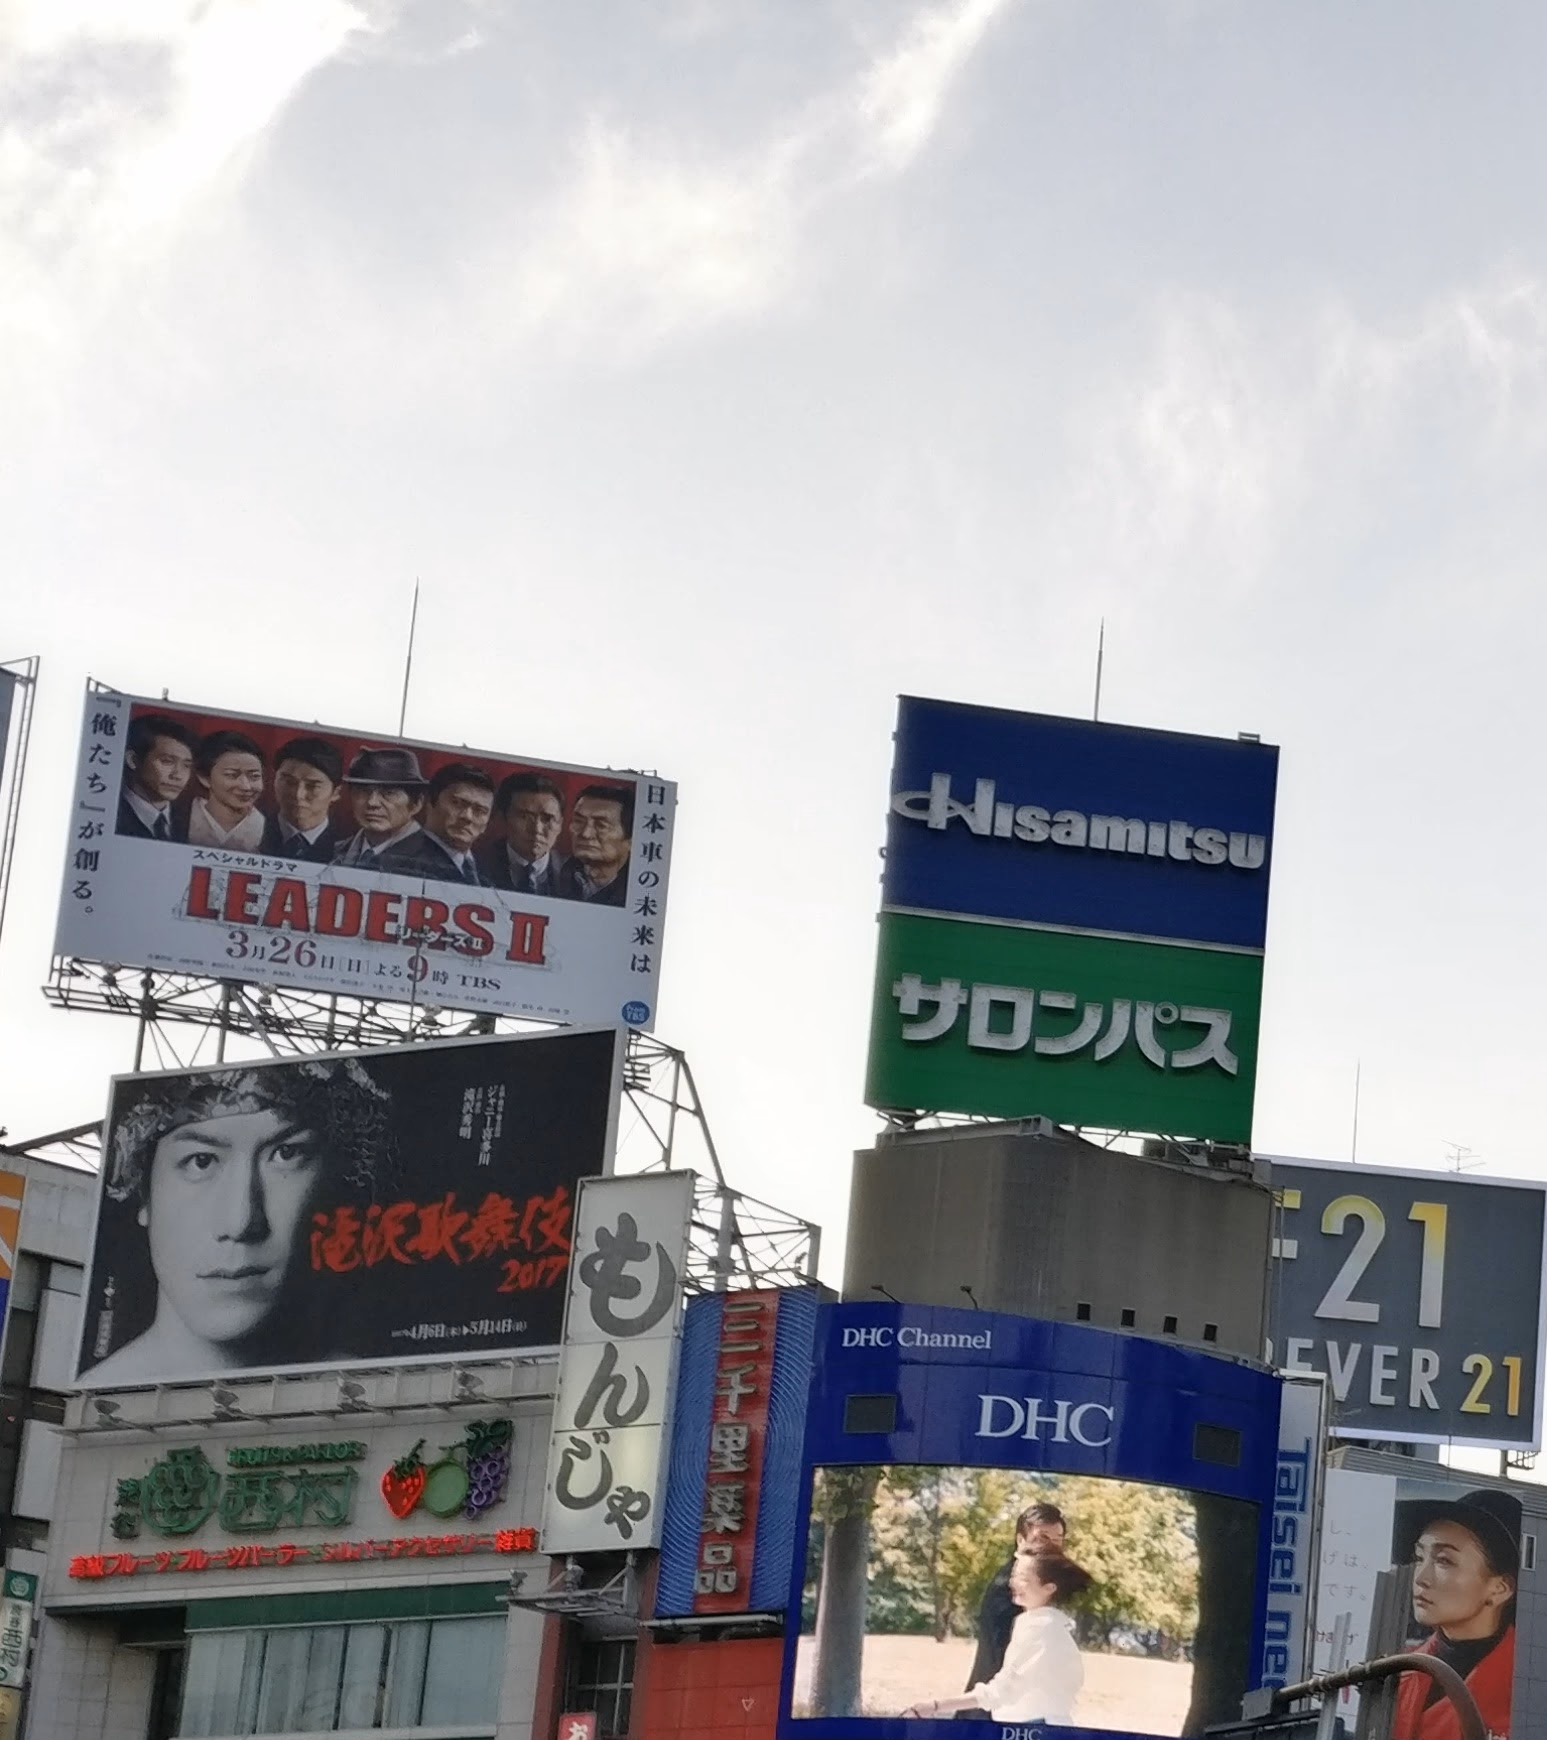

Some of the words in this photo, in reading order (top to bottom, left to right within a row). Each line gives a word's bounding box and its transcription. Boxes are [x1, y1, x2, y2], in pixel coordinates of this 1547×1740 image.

[892, 772, 1265, 869] Hisamitsu
[192, 847, 299, 875] スペシャルドラマ
[629, 784, 667, 974] 日本車の未来は
[185, 865, 496, 959] LEADERS
[456, 973, 502, 991] TBS
[893, 972, 1239, 1075] サロンパス
[497, 1254, 572, 1293] 2017
[842, 1327, 893, 1347] DHC
[897, 1328, 992, 1351] Channel
[555, 1212, 677, 1539] もんじゃ
[1460, 1353, 1522, 1416] 21
[974, 1395, 1115, 1447] DHC
